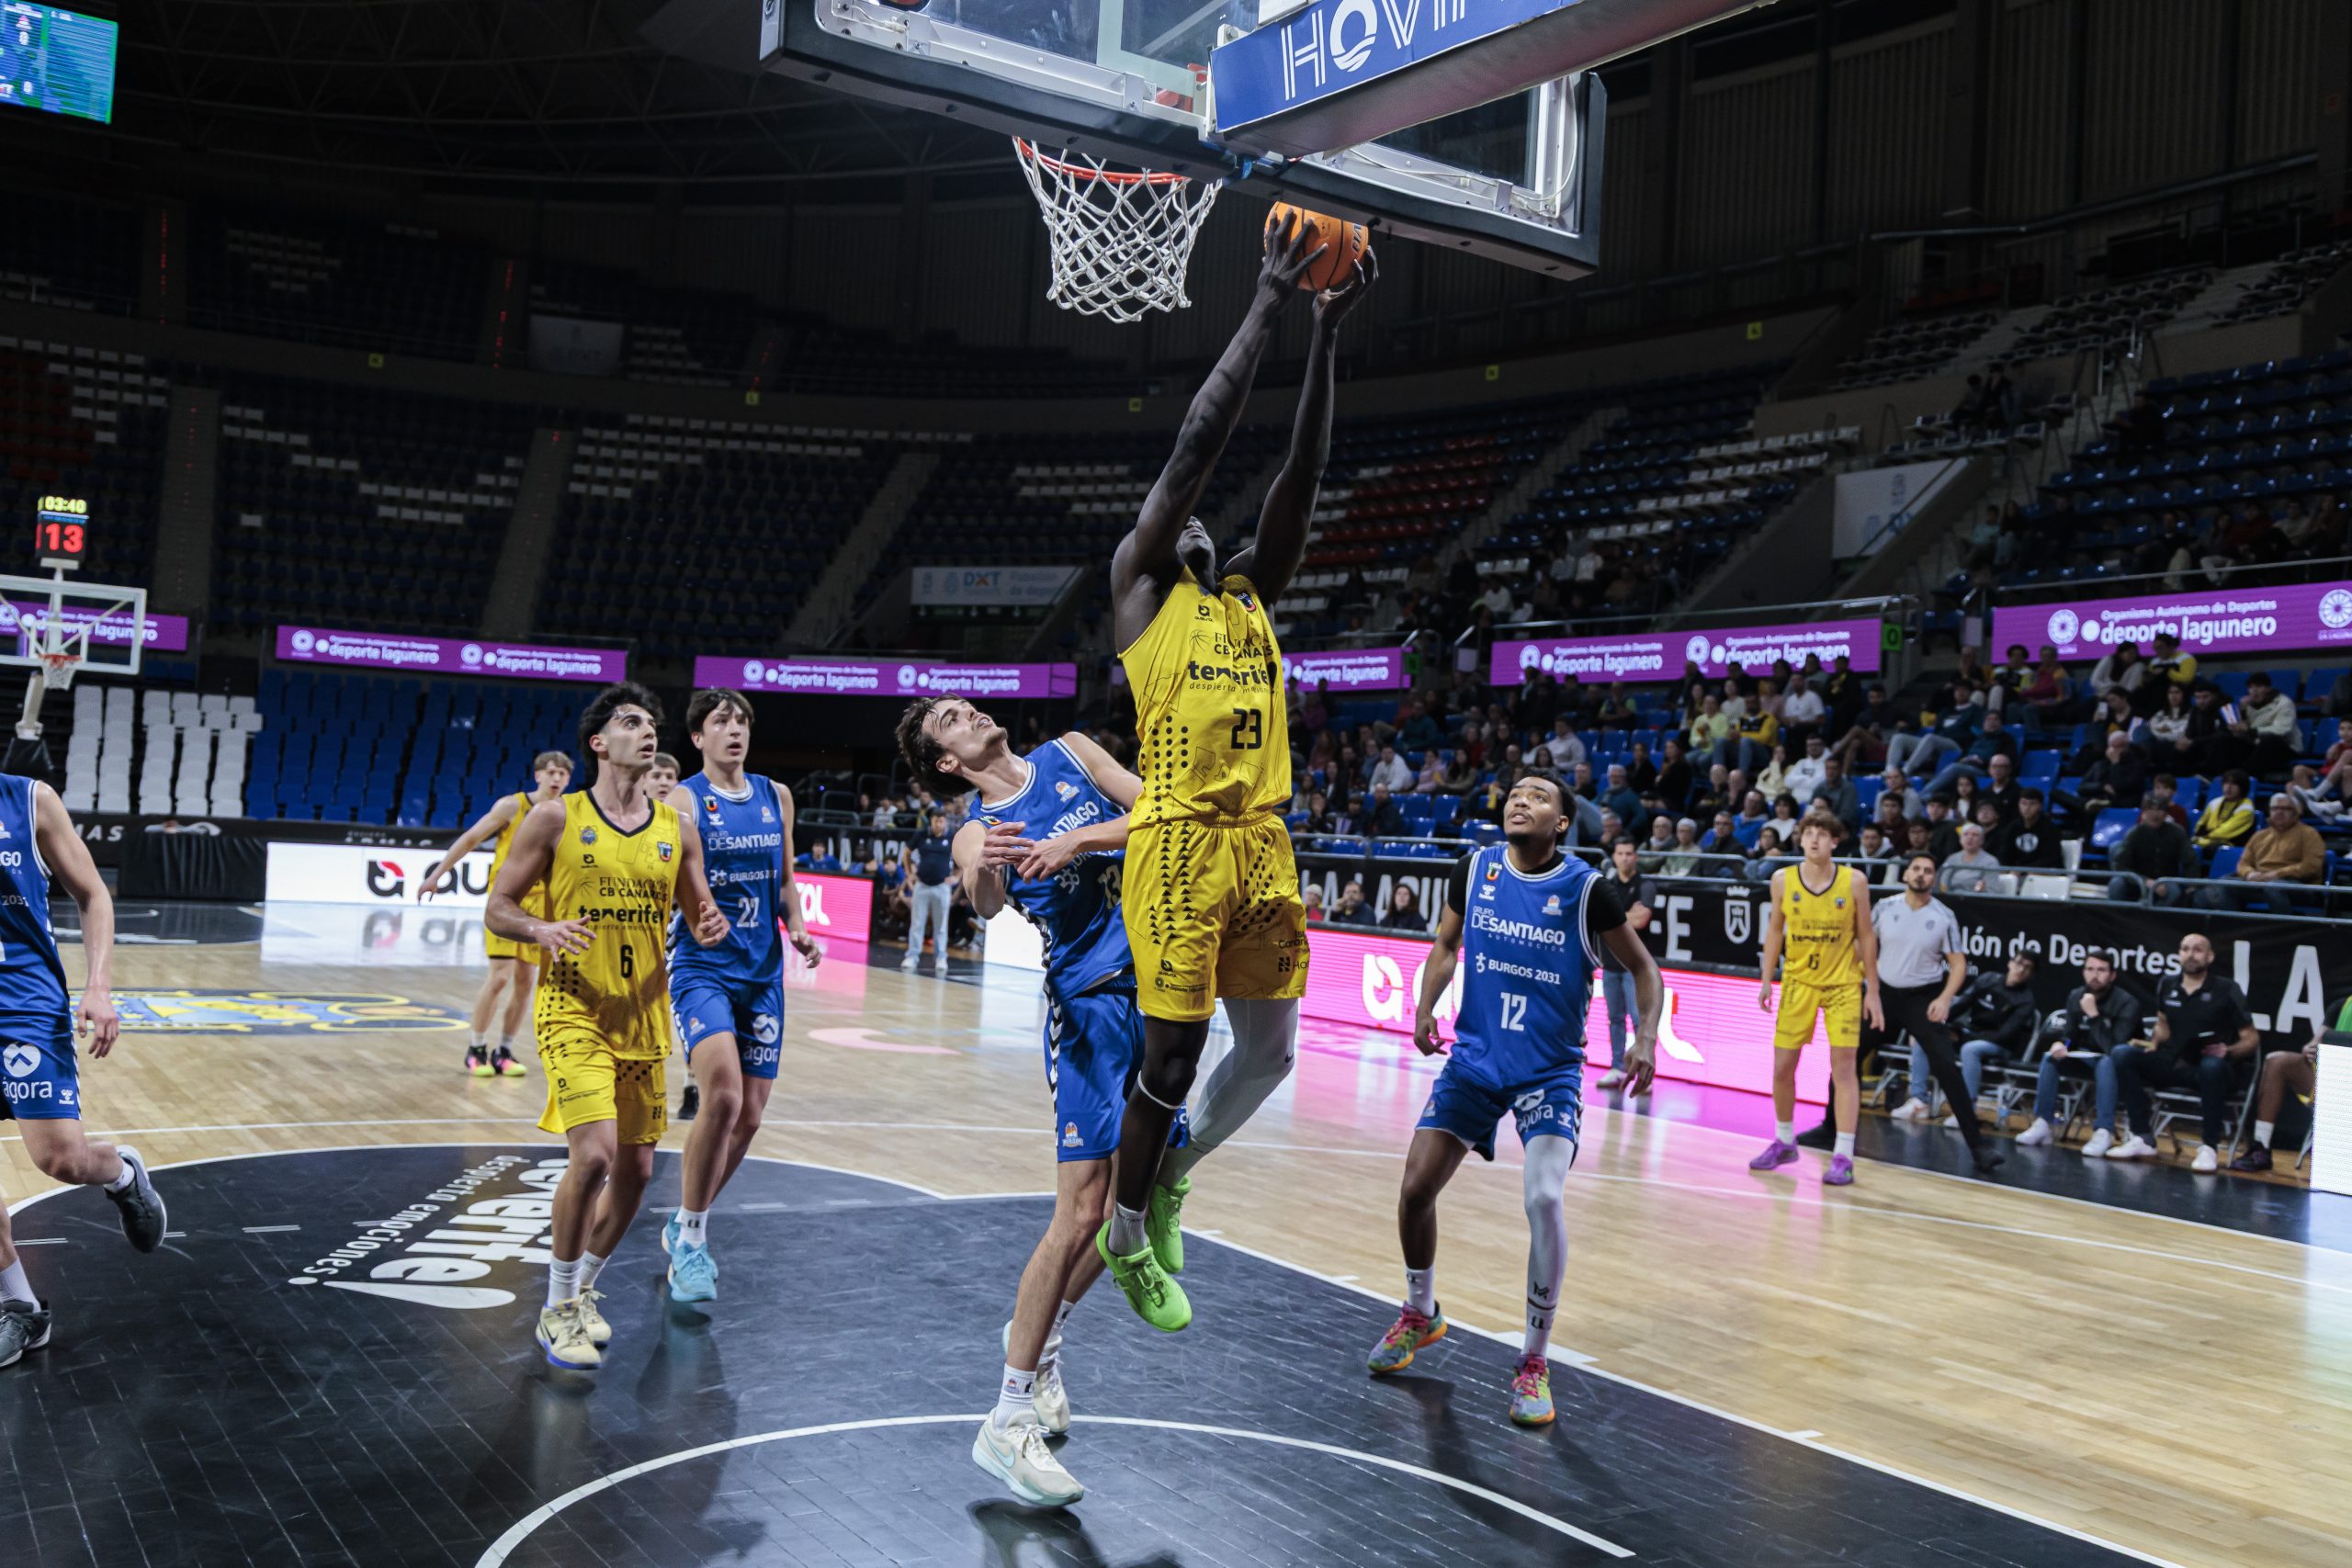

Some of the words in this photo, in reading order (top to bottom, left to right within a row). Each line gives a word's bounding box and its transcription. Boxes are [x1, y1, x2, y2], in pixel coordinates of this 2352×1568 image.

[44, 496, 87, 513] 03:40
[46, 523, 84, 553] 13
[2182, 615, 2277, 645] lagunero
[329, 643, 380, 660] deporte
[381, 646, 439, 664] lagunero
[1554, 655, 1603, 674] deporte
[1604, 653, 1663, 676] lagunero
[496, 656, 545, 672] deporte
[547, 658, 602, 676] lagunero
[1302, 665, 1341, 686] deporte
[1342, 664, 1389, 685] lagunero
[778, 671, 825, 689] deporte
[826, 671, 878, 691] lagunero
[929, 675, 972, 693] deporte
[973, 675, 1020, 694] lagunero
[1189, 682, 1236, 692] despierta
[1231, 707, 1262, 750] 23
[707, 832, 782, 851] DESANTIAGO
[599, 887, 616, 897] CB
[736, 897, 761, 929] 22
[1472, 905, 1495, 916] GRUPO
[1471, 912, 1566, 946] DESANTIAGO
[620, 944, 634, 979] 6
[1488, 959, 1533, 978] BURGOS
[1534, 968, 1562, 985] 2031
[2233, 940, 2326, 1039] LA
[1500, 991, 1527, 1032] 12
[302, 1203, 441, 1275] emociones
